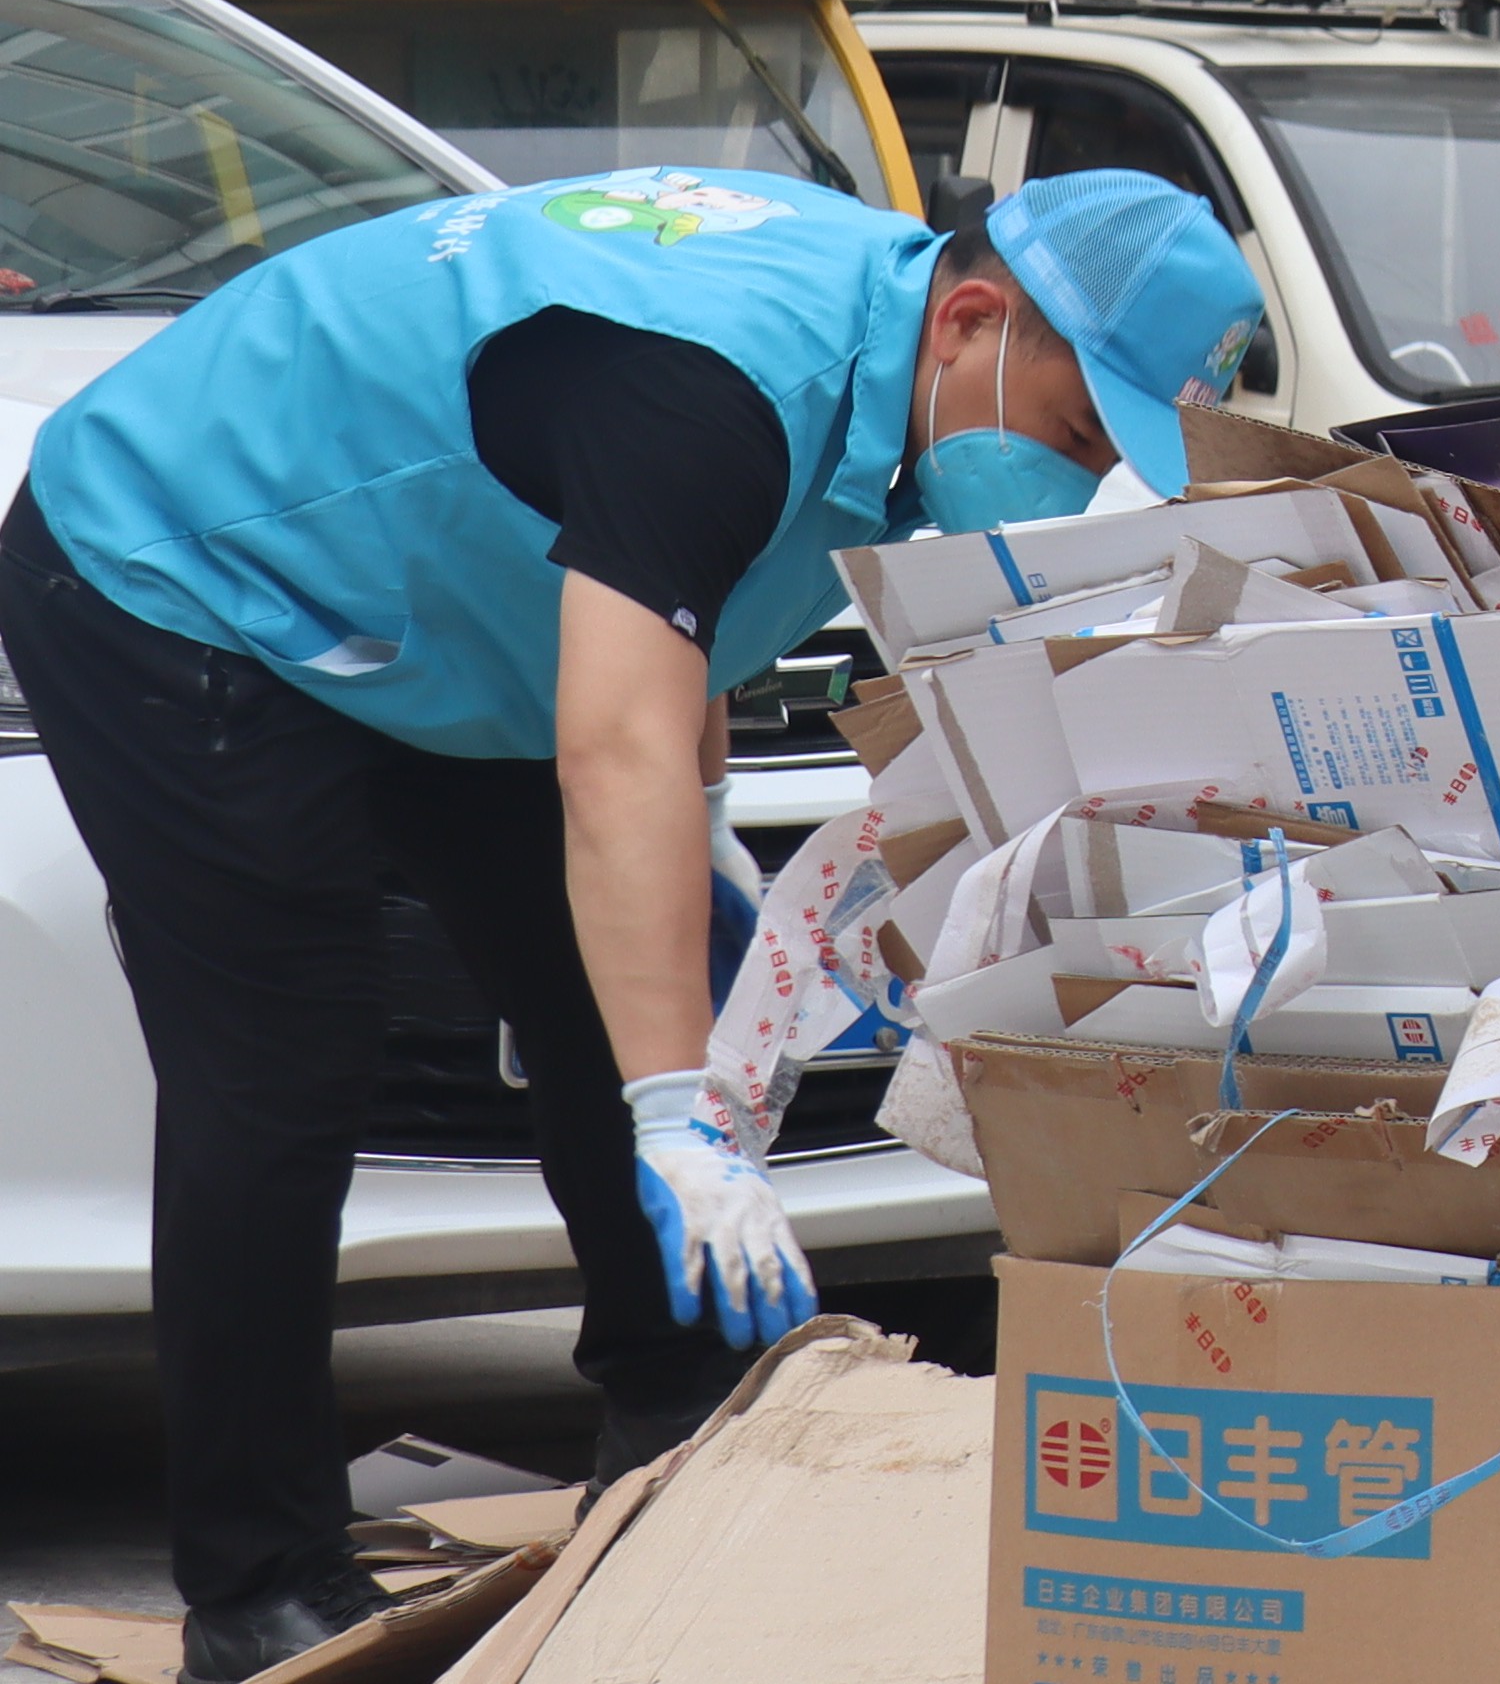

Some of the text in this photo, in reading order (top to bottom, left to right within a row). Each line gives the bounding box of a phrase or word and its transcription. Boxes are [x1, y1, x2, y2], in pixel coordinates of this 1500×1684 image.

[1138, 1411, 1421, 1527] 日丰管
[1038, 1578, 1283, 1625] 日丰企业集团有限公司
